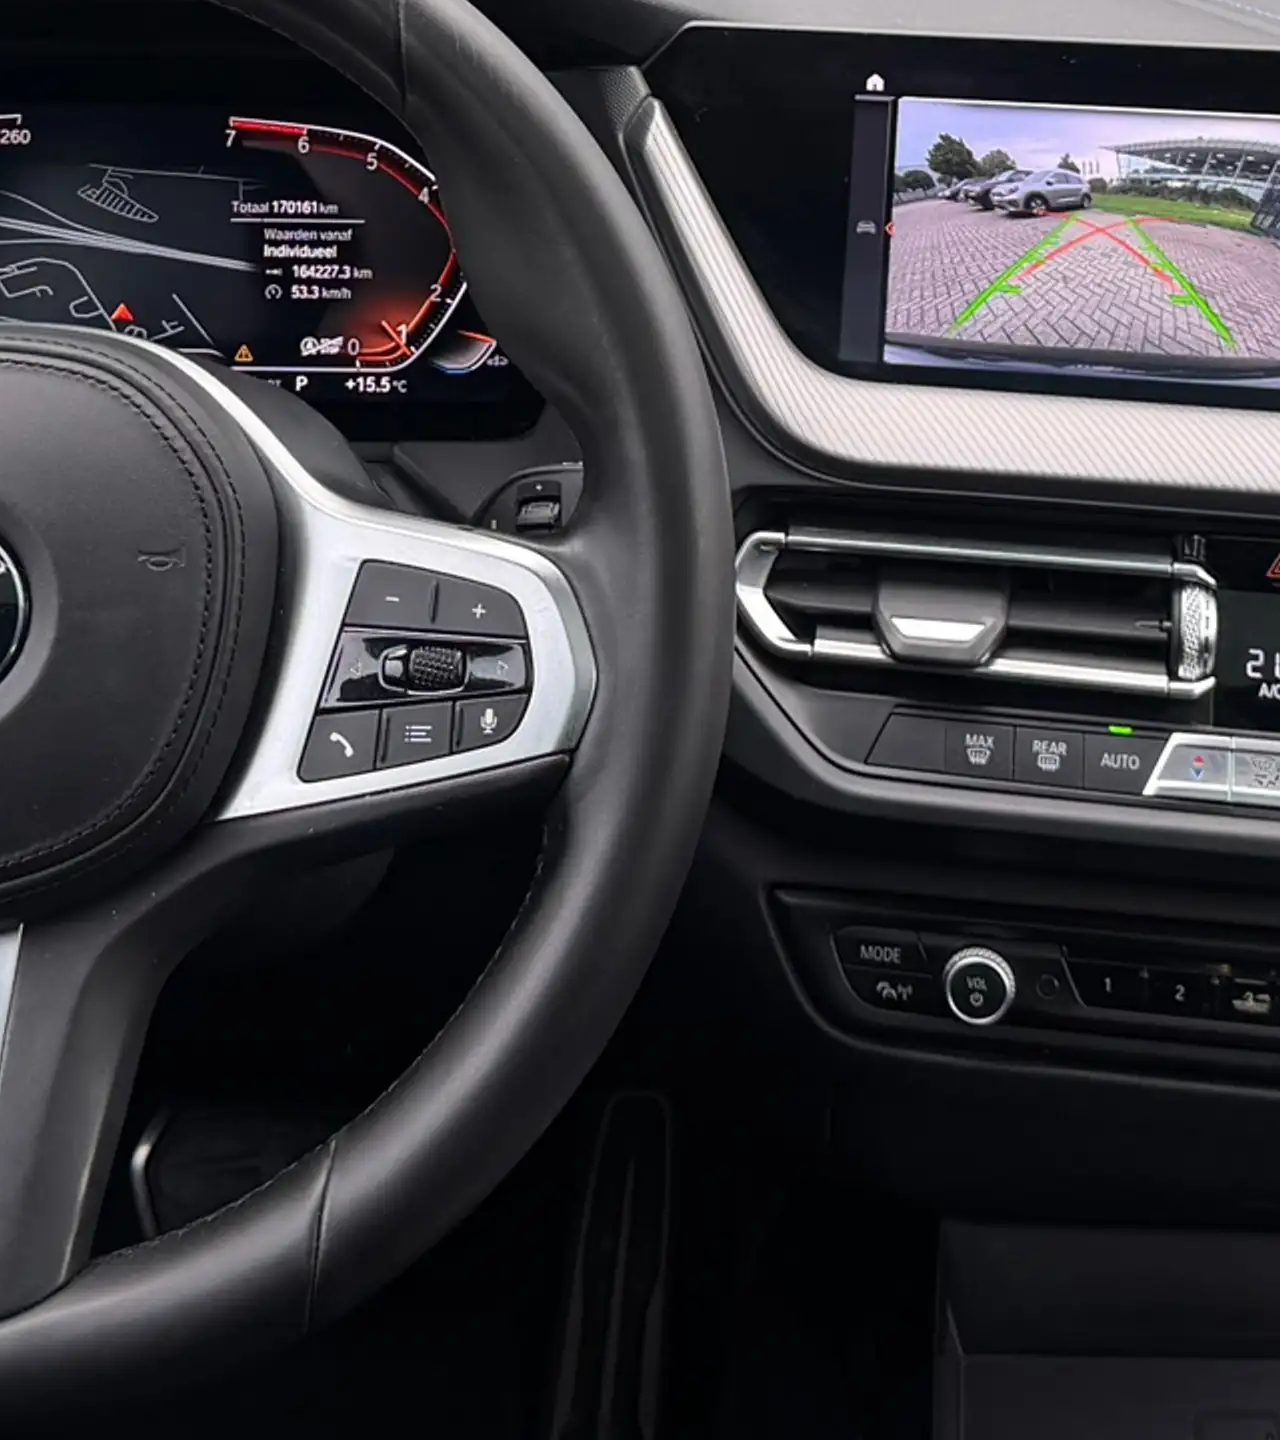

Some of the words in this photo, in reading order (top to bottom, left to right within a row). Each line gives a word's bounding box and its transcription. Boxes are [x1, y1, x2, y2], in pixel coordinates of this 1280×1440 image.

[0, 128, 31, 145] 260
[224, 129, 237, 147] 7
[297, 137, 310, 154] 6
[366, 153, 378, 171] 5
[418, 187, 430, 204] 4
[231, 200, 269, 214] Totaal
[271, 200, 318, 214] 170161
[319, 203, 339, 214] km
[263, 227, 318, 241] Waarden
[319, 227, 353, 241] vanaf
[263, 244, 338, 258] Individueel
[291, 265, 351, 279] 164227.3
[353, 267, 373, 279] km
[291, 284, 320, 299] 53.3
[321, 286, 352, 299] km/h
[429, 284, 442, 301] 2
[396, 324, 409, 343] 1
[348, 337, 360, 356] 0
[295, 375, 309, 392] P
[964, 733, 995, 749] MAX
[1031, 739, 1067, 756] REAR
[1100, 752, 1140, 770] AUTO
[860, 945, 902, 964] MODE
[966, 975, 988, 992] VOL
[1103, 976, 1112, 993] 1
[1174, 984, 1185, 1001] 2
